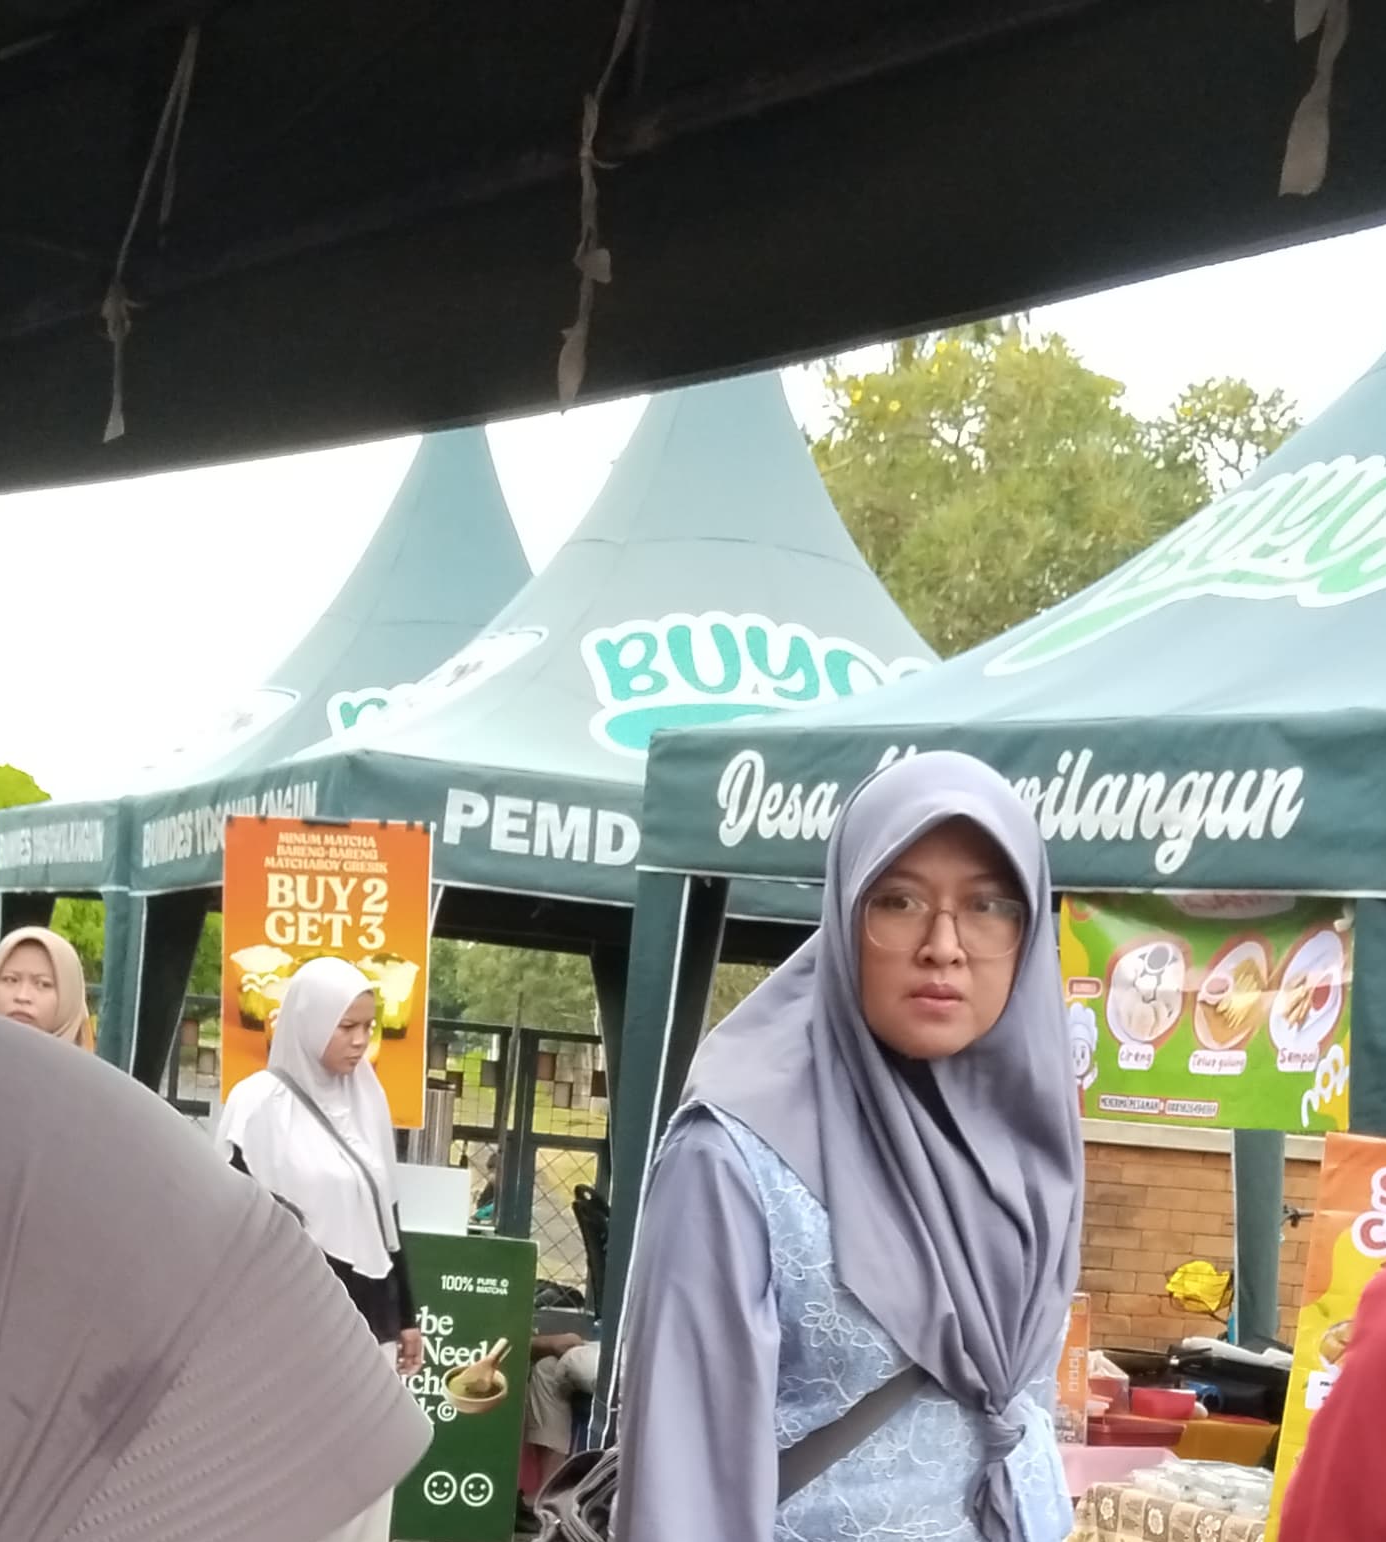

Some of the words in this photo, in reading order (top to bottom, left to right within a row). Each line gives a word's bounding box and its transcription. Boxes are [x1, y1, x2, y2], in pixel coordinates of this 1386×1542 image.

[718, 749, 841, 848] Desa
[278, 832, 322, 847] MINUM
[324, 834, 377, 848] MATCHA
[443, 788, 640, 868] PEMD
[266, 873, 358, 912] BUY
[362, 877, 389, 913] 2
[265, 910, 353, 948] GET
[357, 914, 386, 950] 3
[440, 1275, 474, 1293] 100%
[421, 1336, 489, 1368] Need
